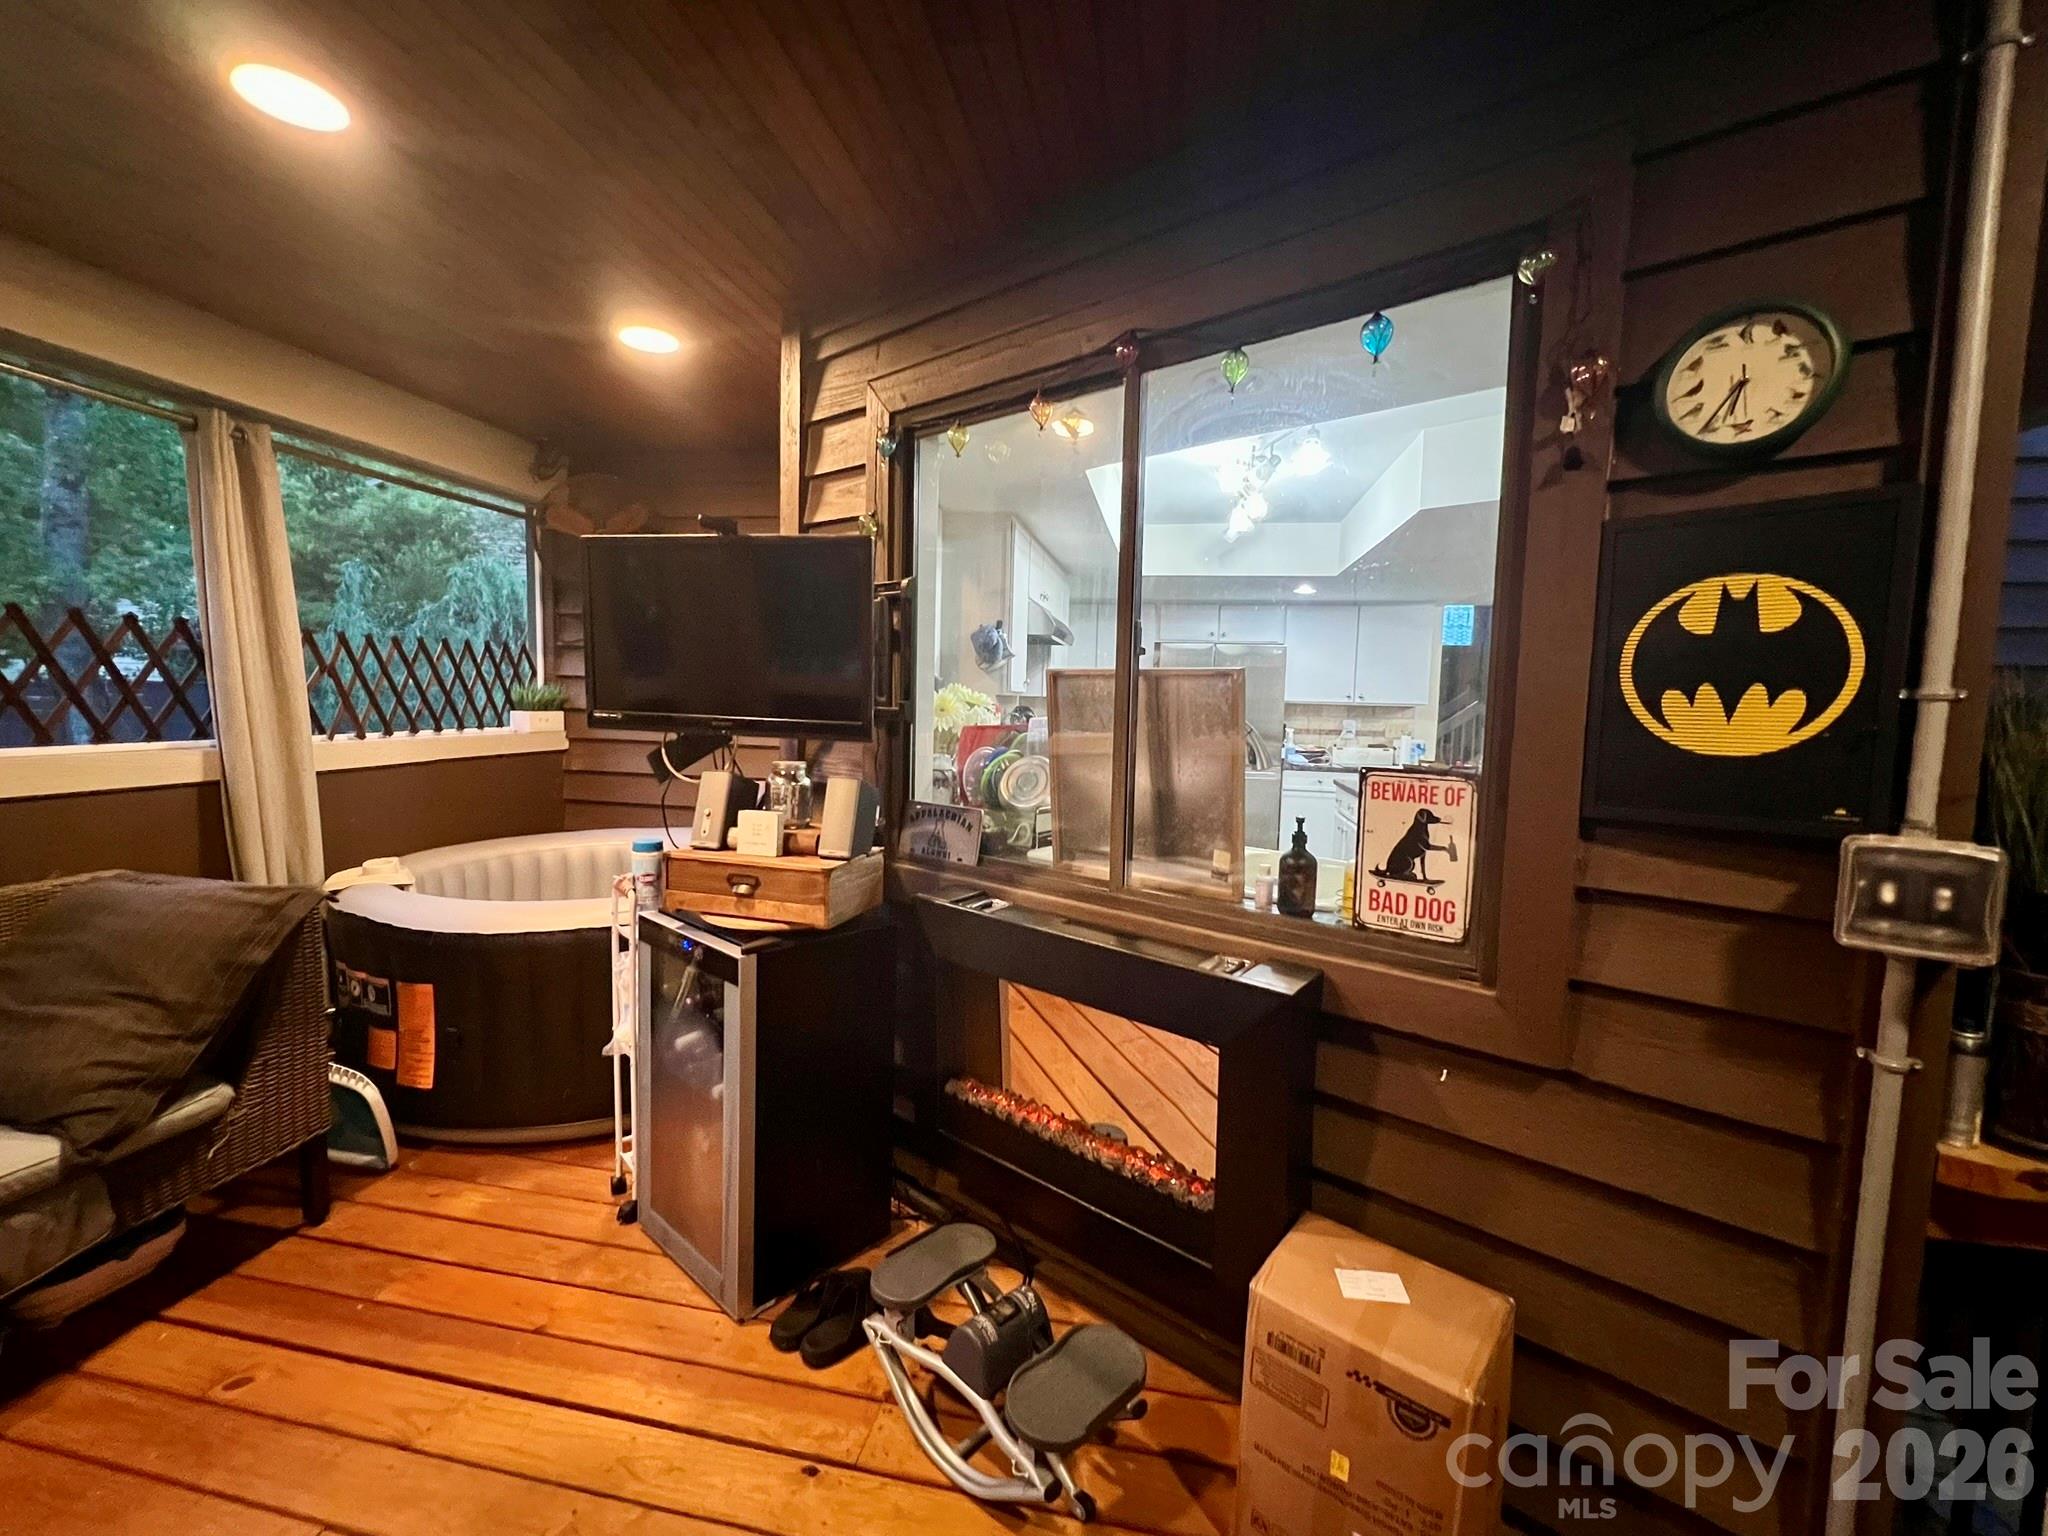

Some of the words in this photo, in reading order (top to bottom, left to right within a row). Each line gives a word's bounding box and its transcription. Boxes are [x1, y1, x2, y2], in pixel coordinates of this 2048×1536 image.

[1371, 781, 1439, 805] BEWARE
[1445, 785, 1467, 806] OF
[909, 807, 974, 833] APPALACHIAN
[921, 846, 951, 860] ALUMNI
[1368, 888, 1408, 916] BAD
[1414, 895, 1456, 925] DOG
[1376, 914, 1398, 927] ENTER
[1399, 918, 1409, 928] AT
[1410, 919, 1427, 931] OWN
[1427, 922, 1444, 934] RISK
